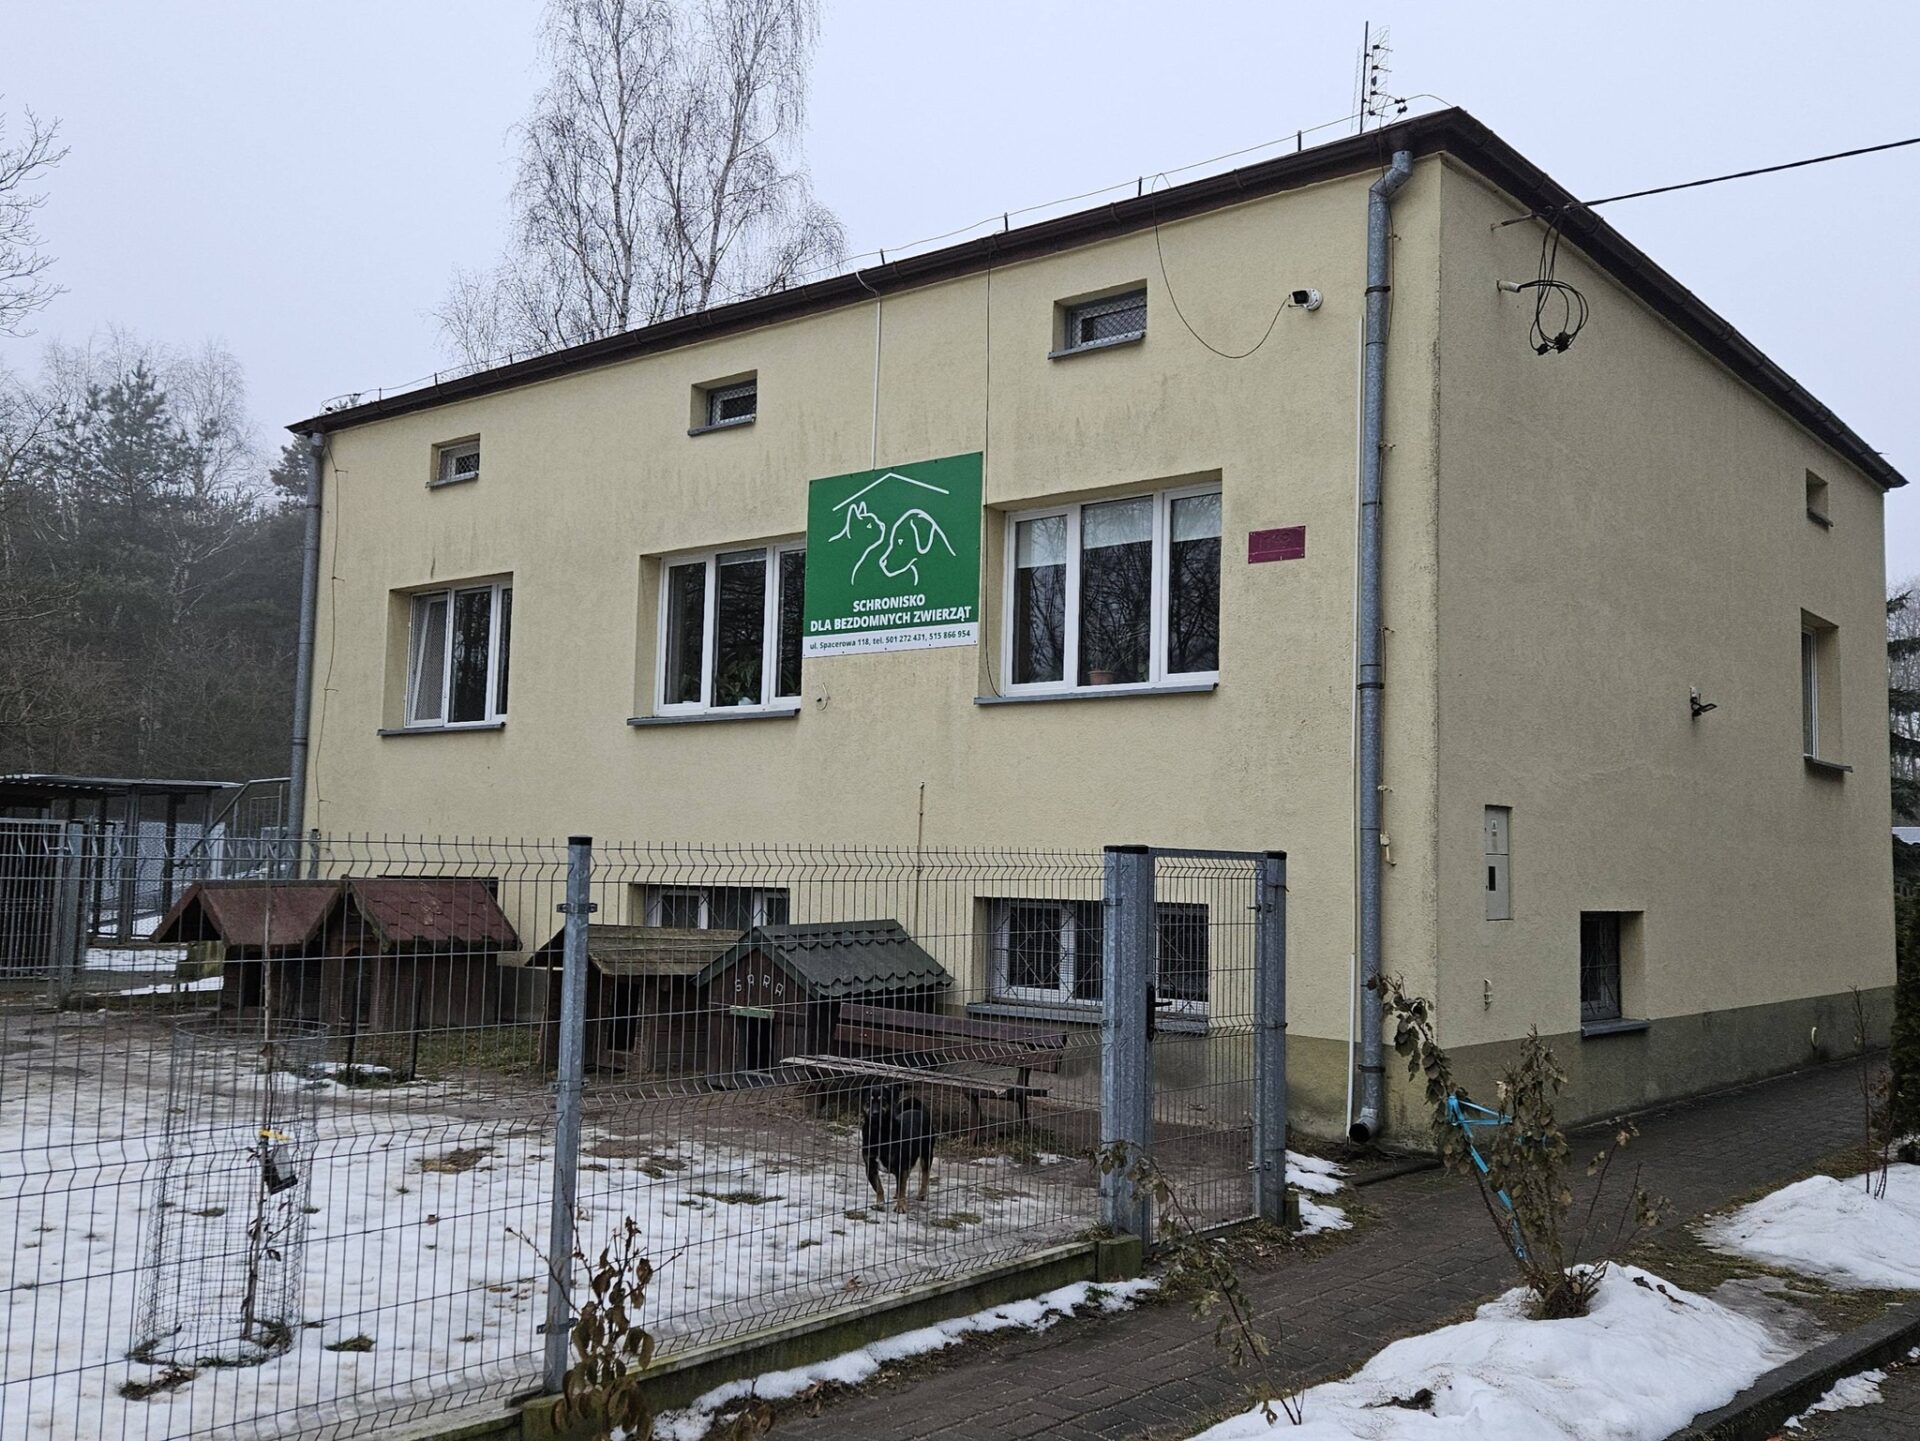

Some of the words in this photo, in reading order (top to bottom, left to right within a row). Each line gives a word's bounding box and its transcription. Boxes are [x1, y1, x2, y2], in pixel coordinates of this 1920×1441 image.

[853, 594, 926, 613] SCHRONISKO
[810, 619, 832, 632] DLA
[834, 611, 911, 630] BEZDOMNYCH
[913, 606, 972, 623] ZWIERZĄT
[809, 642, 818, 650] ul.
[819, 638, 856, 651] Spacerowa
[857, 638, 871, 647] 118,
[872, 637, 884, 645] tel.
[885, 636, 898, 644] 501
[899, 635, 911, 643] 272
[913, 634, 927, 642] 431,
[929, 632, 942, 641] 515
[943, 631, 956, 639] 866
[957, 630, 971, 638] 954
[734, 974, 784, 997] SARA
